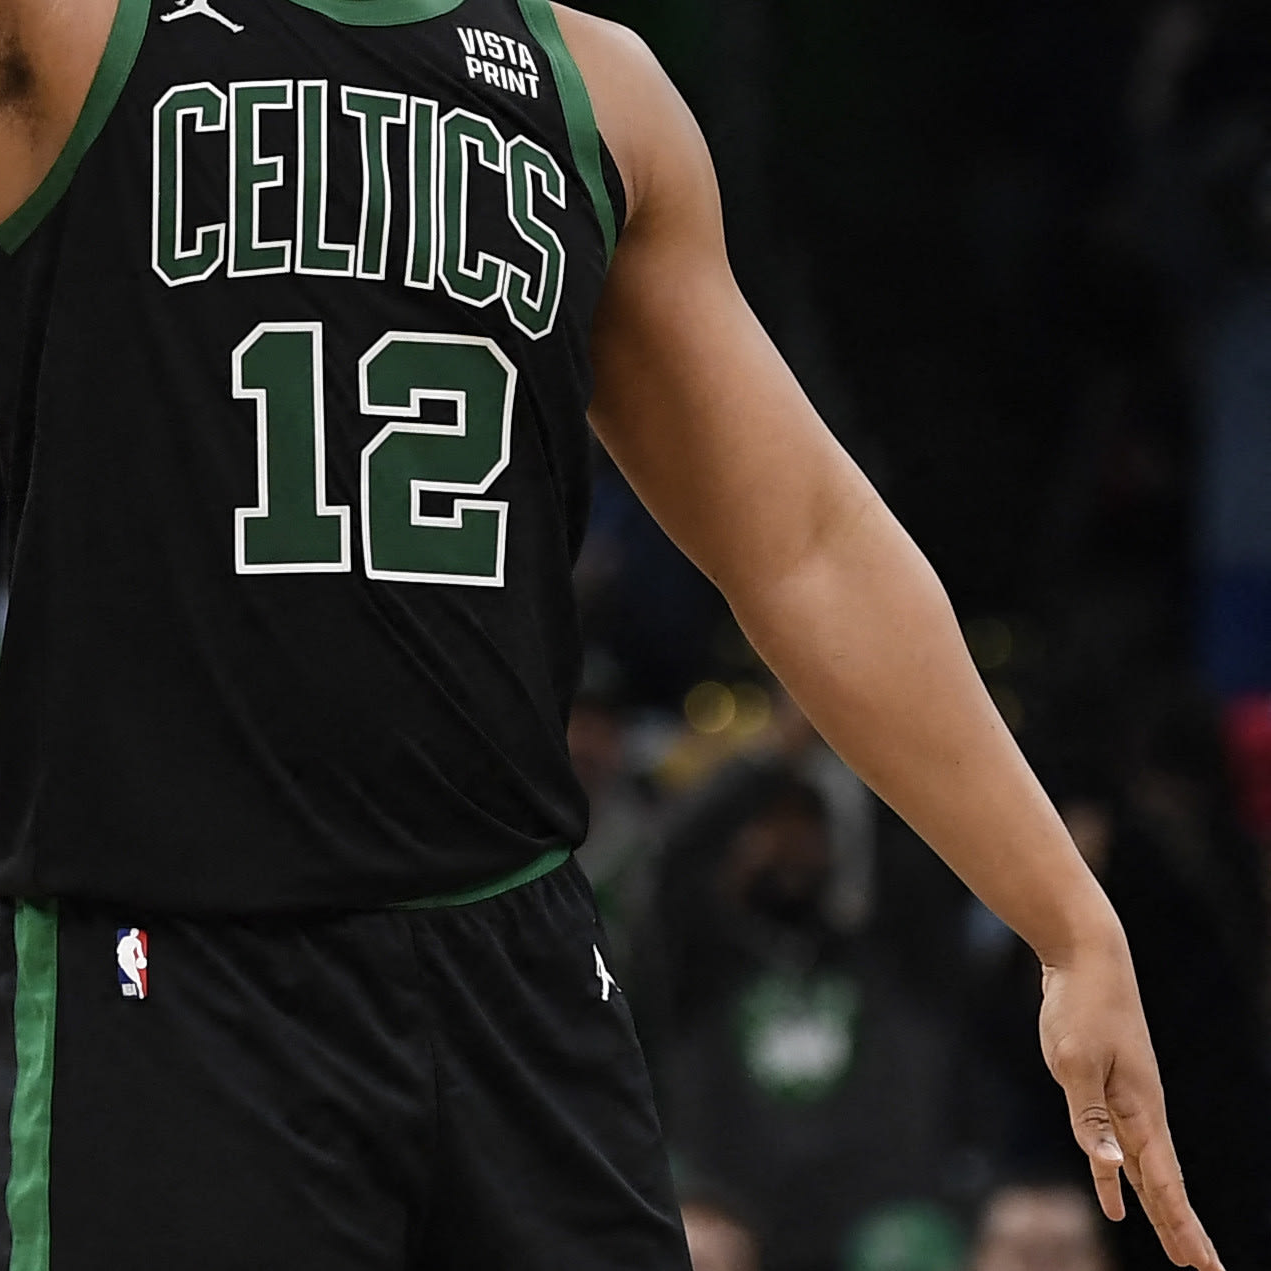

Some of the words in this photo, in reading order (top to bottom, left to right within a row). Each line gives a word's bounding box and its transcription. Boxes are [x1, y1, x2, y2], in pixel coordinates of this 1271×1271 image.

[457, 27, 538, 75] VISTA
[465, 55, 540, 99] PRINT
[152, 80, 565, 339] CELTICS
[232, 322, 517, 587] 12
